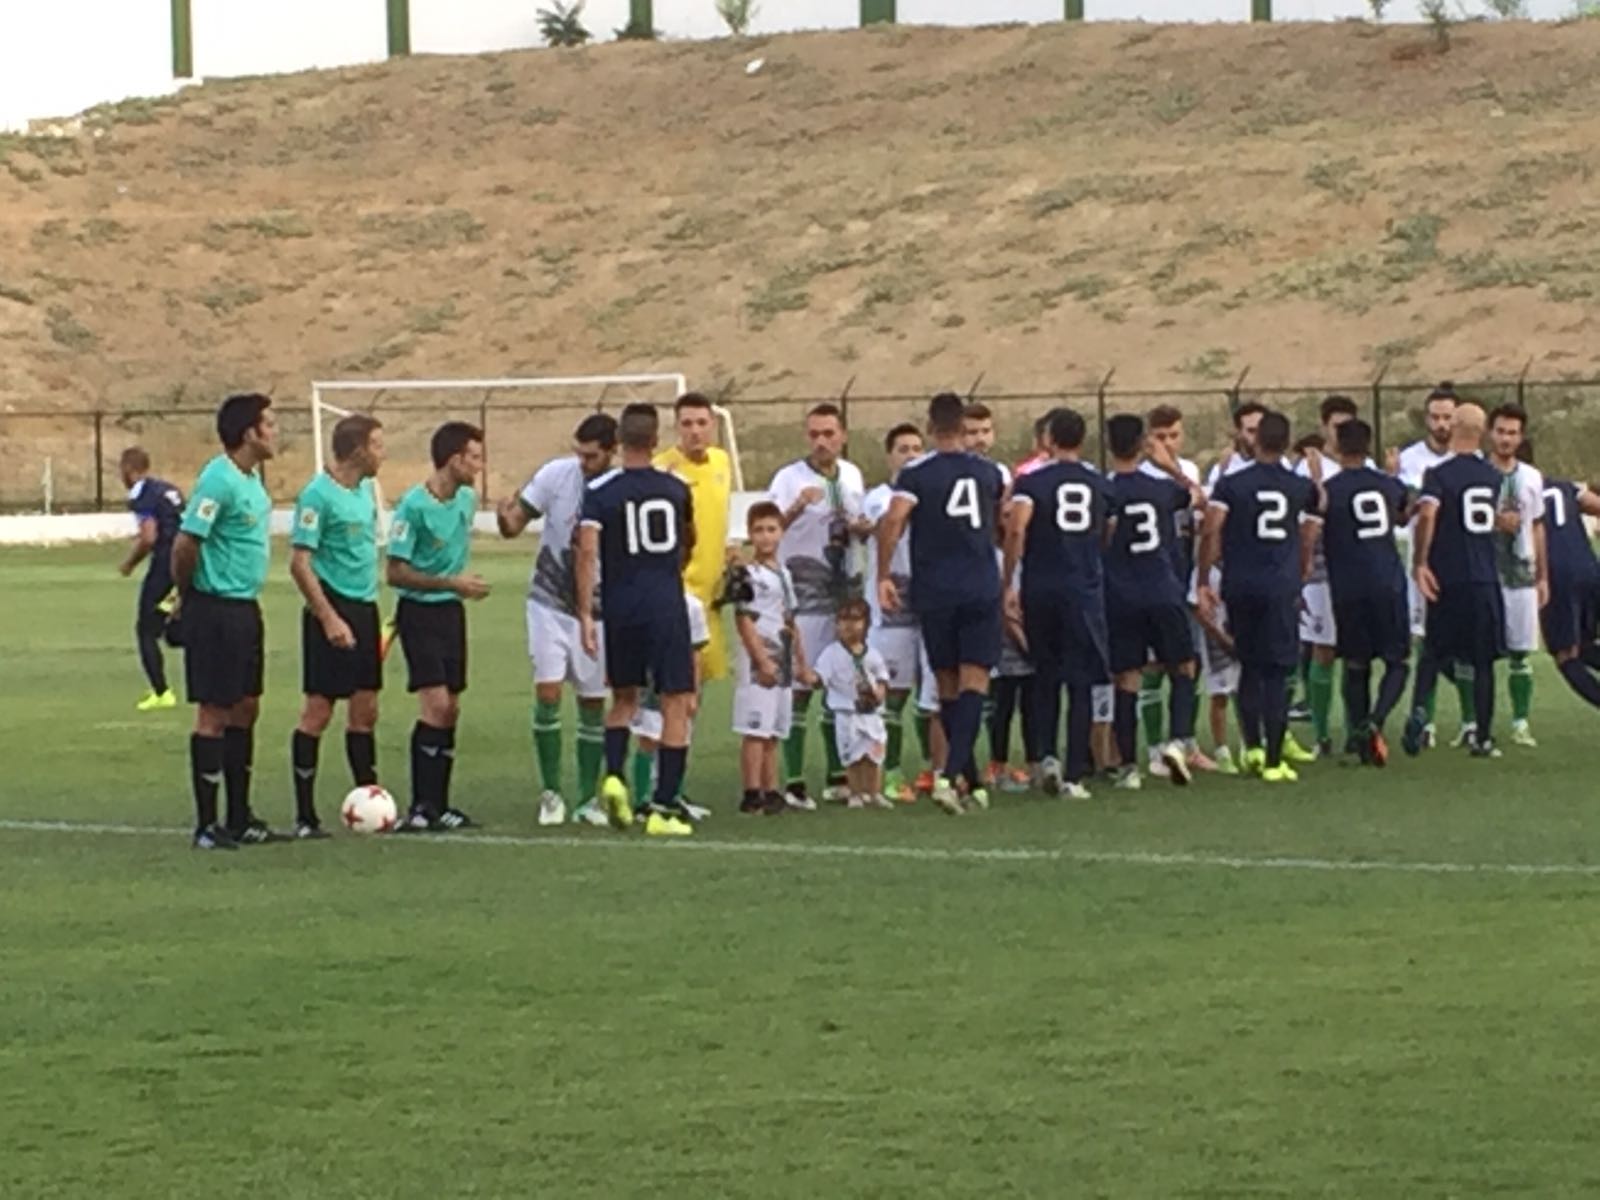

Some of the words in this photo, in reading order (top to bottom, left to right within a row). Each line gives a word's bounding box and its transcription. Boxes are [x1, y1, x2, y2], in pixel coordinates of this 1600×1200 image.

[625, 498, 677, 554] 10
[945, 477, 982, 529] 4
[1056, 482, 1092, 532] 8
[1124, 502, 1160, 553] 3
[1256, 490, 1288, 539] 2
[1352, 490, 1389, 539] 9
[1463, 486, 1495, 534] 6
